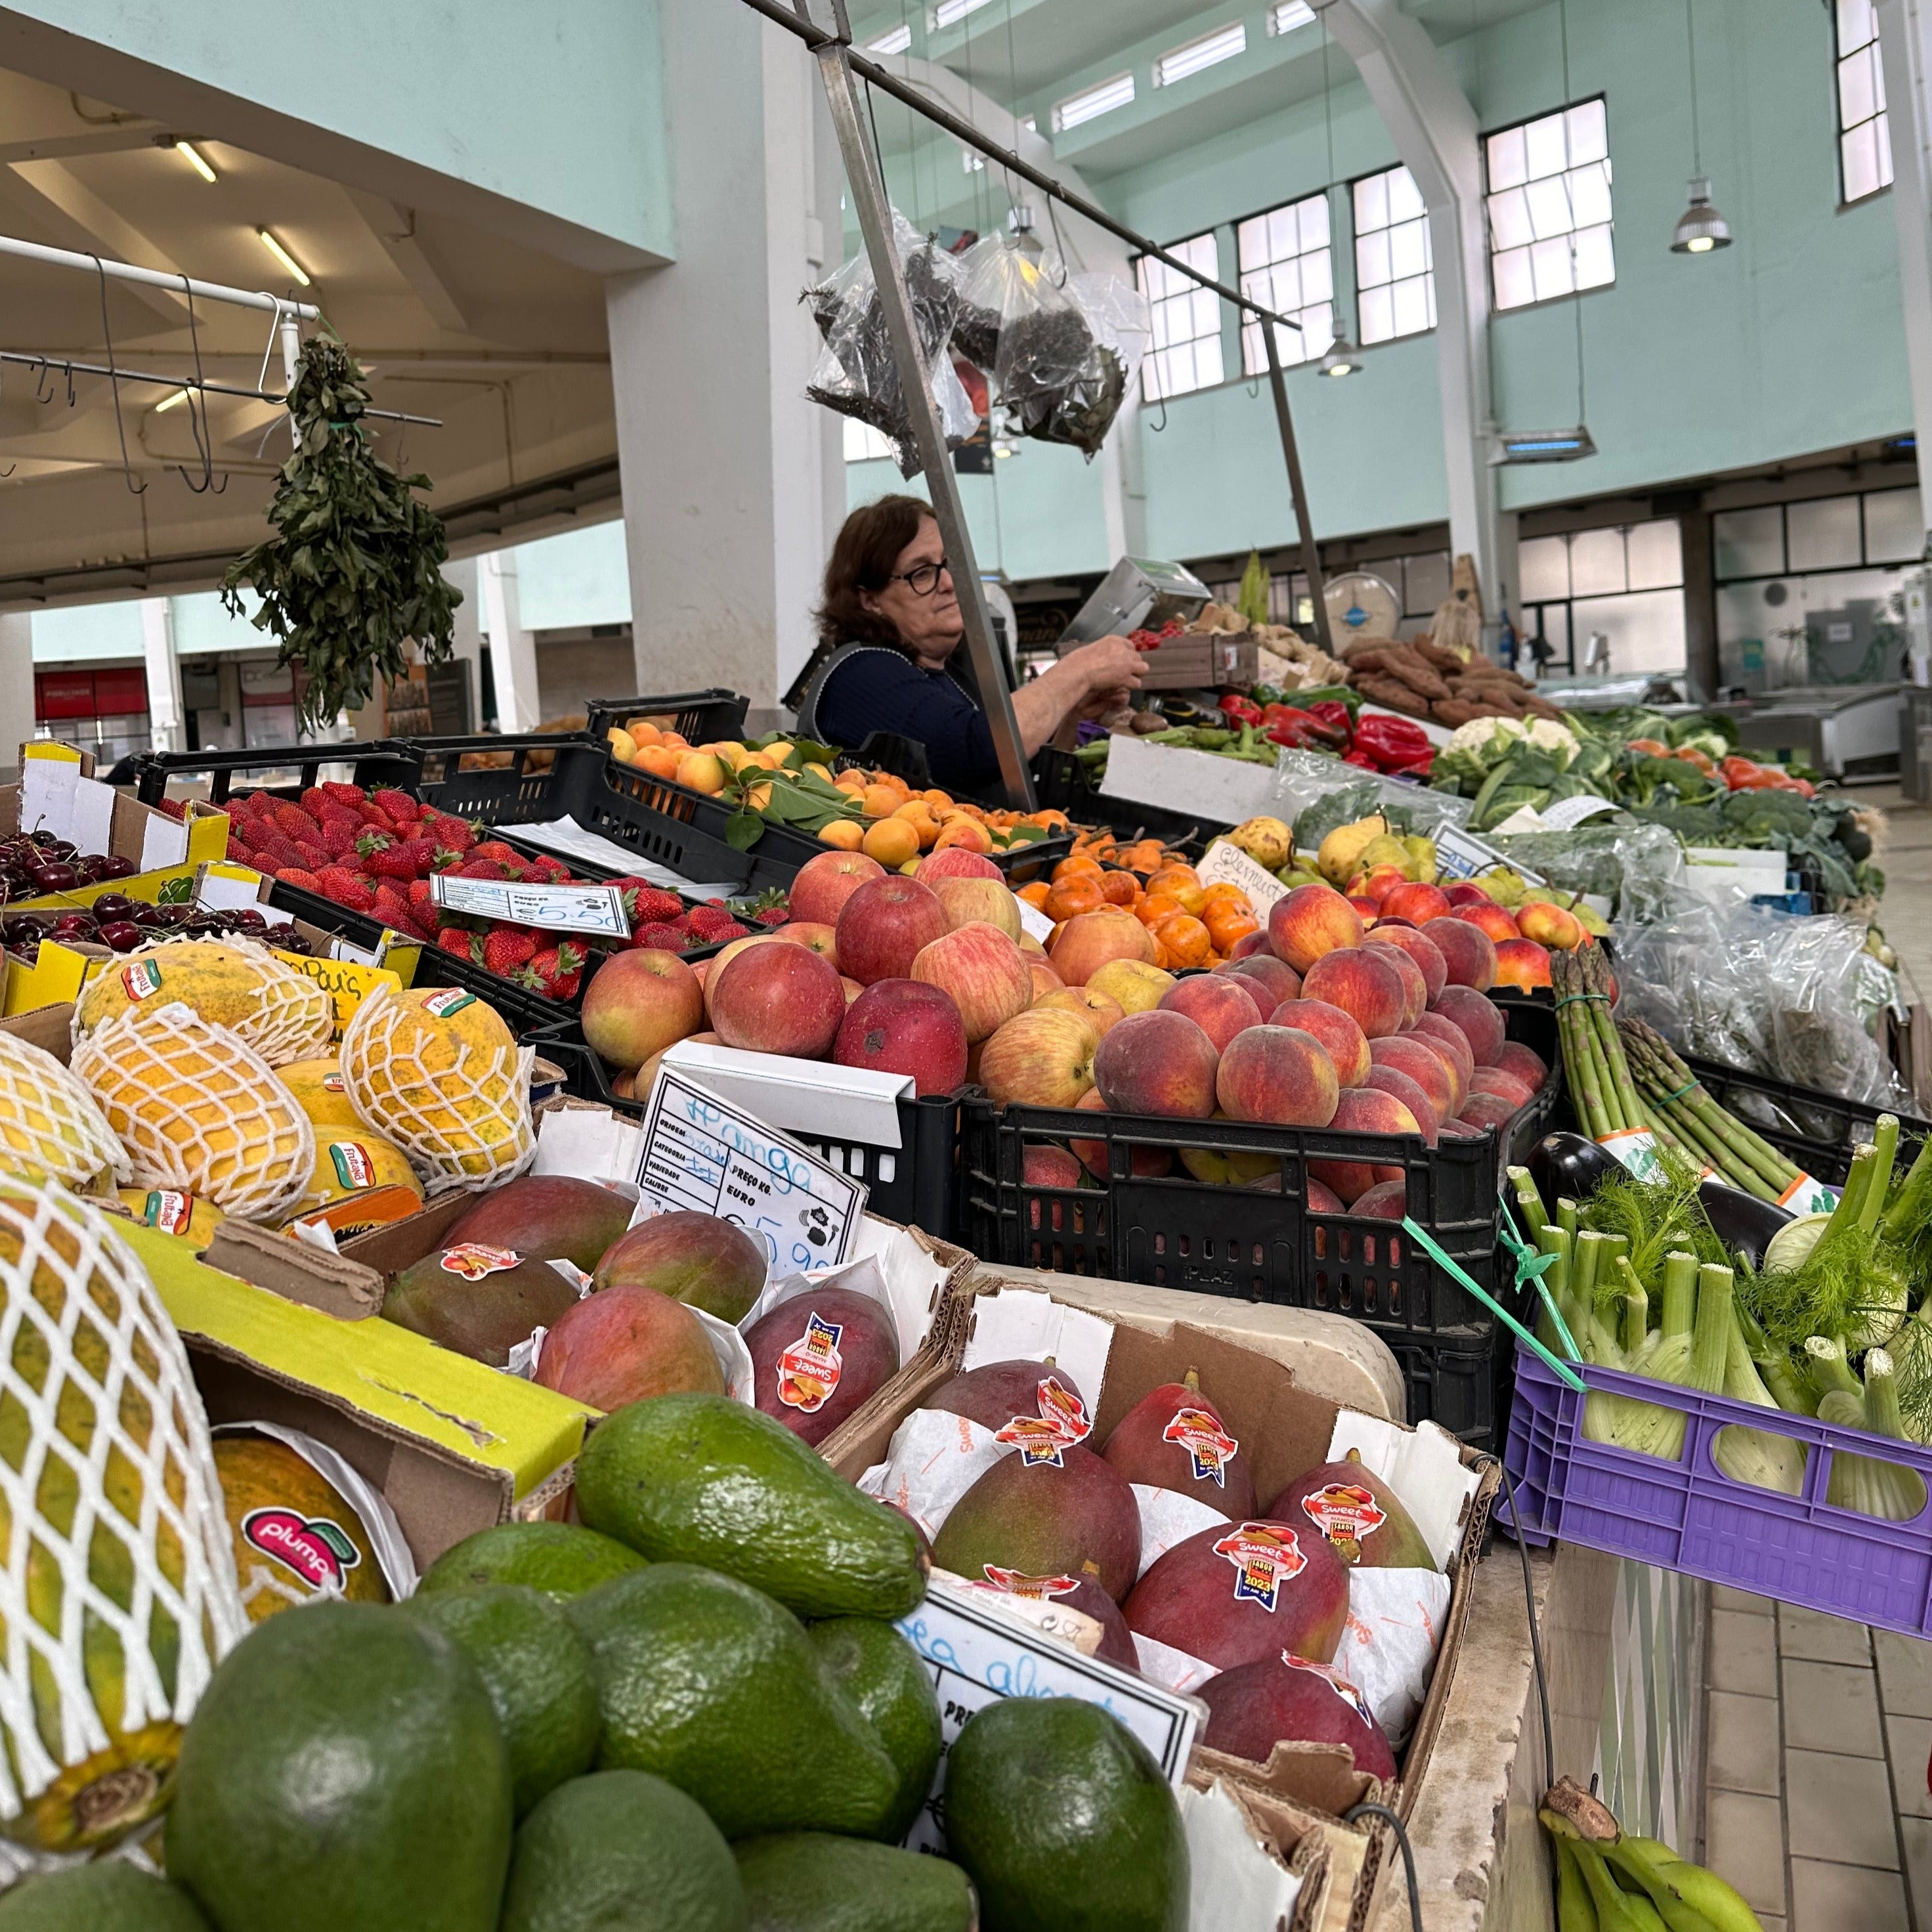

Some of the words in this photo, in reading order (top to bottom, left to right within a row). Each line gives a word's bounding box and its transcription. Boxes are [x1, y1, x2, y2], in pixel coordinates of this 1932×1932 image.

[659, 1119, 686, 1137] ORIGEM
[654, 1141, 686, 1162] CATEGORIA
[649, 1161, 681, 1181] VARIEDADE
[645, 1177, 669, 1193] CALIBRE
[731, 1165, 758, 1187] PREÇO
[758, 1182, 771, 1196] KG.
[726, 1184, 755, 1206] EURO
[812, 1329, 834, 1342] 2023
[808, 1343, 826, 1356] SABOR
[794, 1358, 832, 1381] Sweet
[1044, 1396, 1074, 1427] Sweet
[1183, 1427, 1220, 1444] Sweet
[1321, 1504, 1363, 1518] Sweet
[1239, 1543, 1284, 1560] Sweet
[1252, 1560, 1273, 1572] SABOR
[1245, 1575, 1271, 1593] 2023
